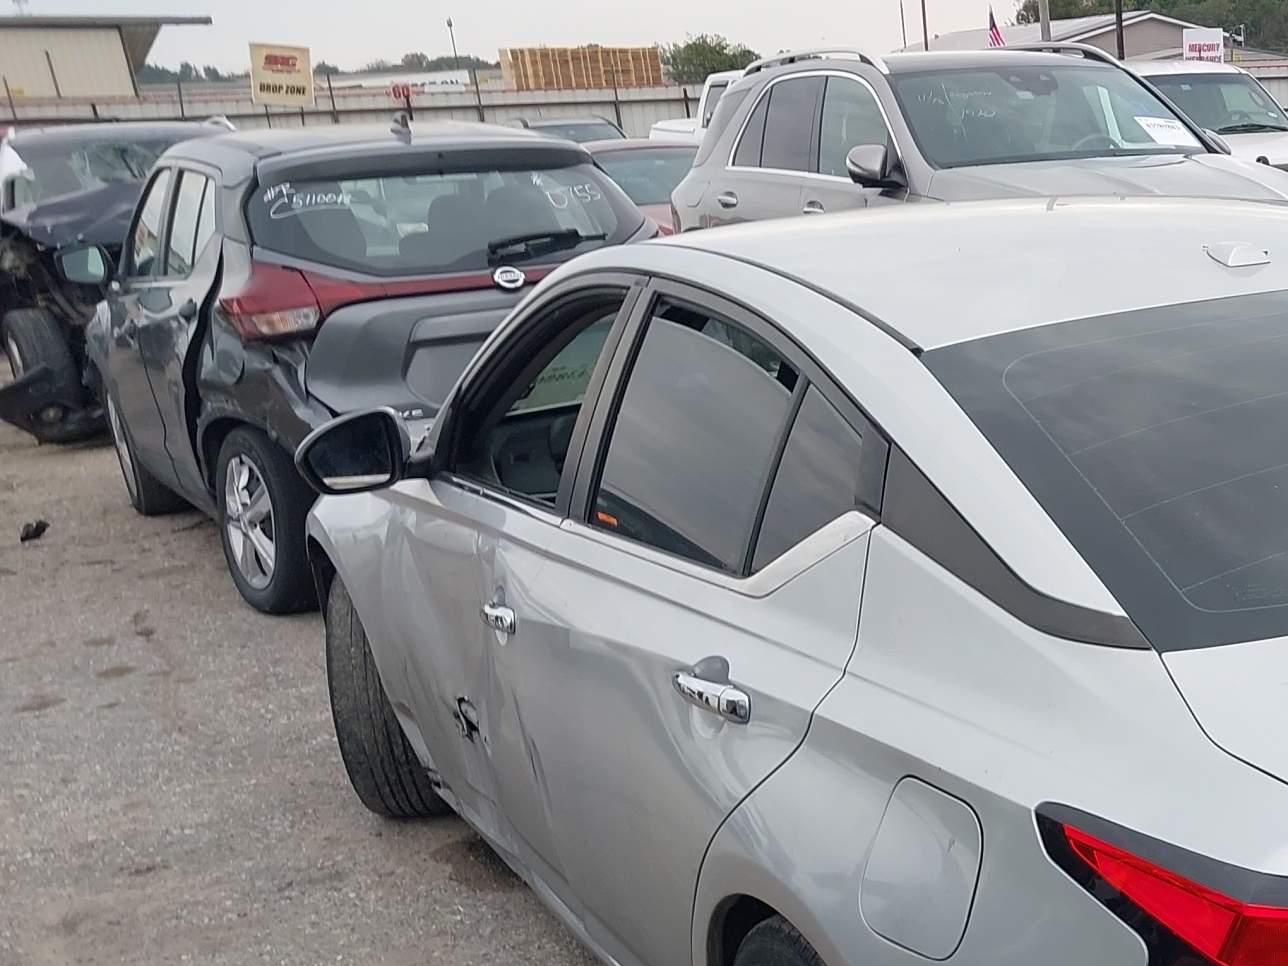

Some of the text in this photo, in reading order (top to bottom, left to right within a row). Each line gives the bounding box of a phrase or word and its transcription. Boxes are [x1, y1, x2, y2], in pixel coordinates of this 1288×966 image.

[1188, 43, 1221, 53] MERCURY
[259, 82, 307, 96] DROP ZONE
